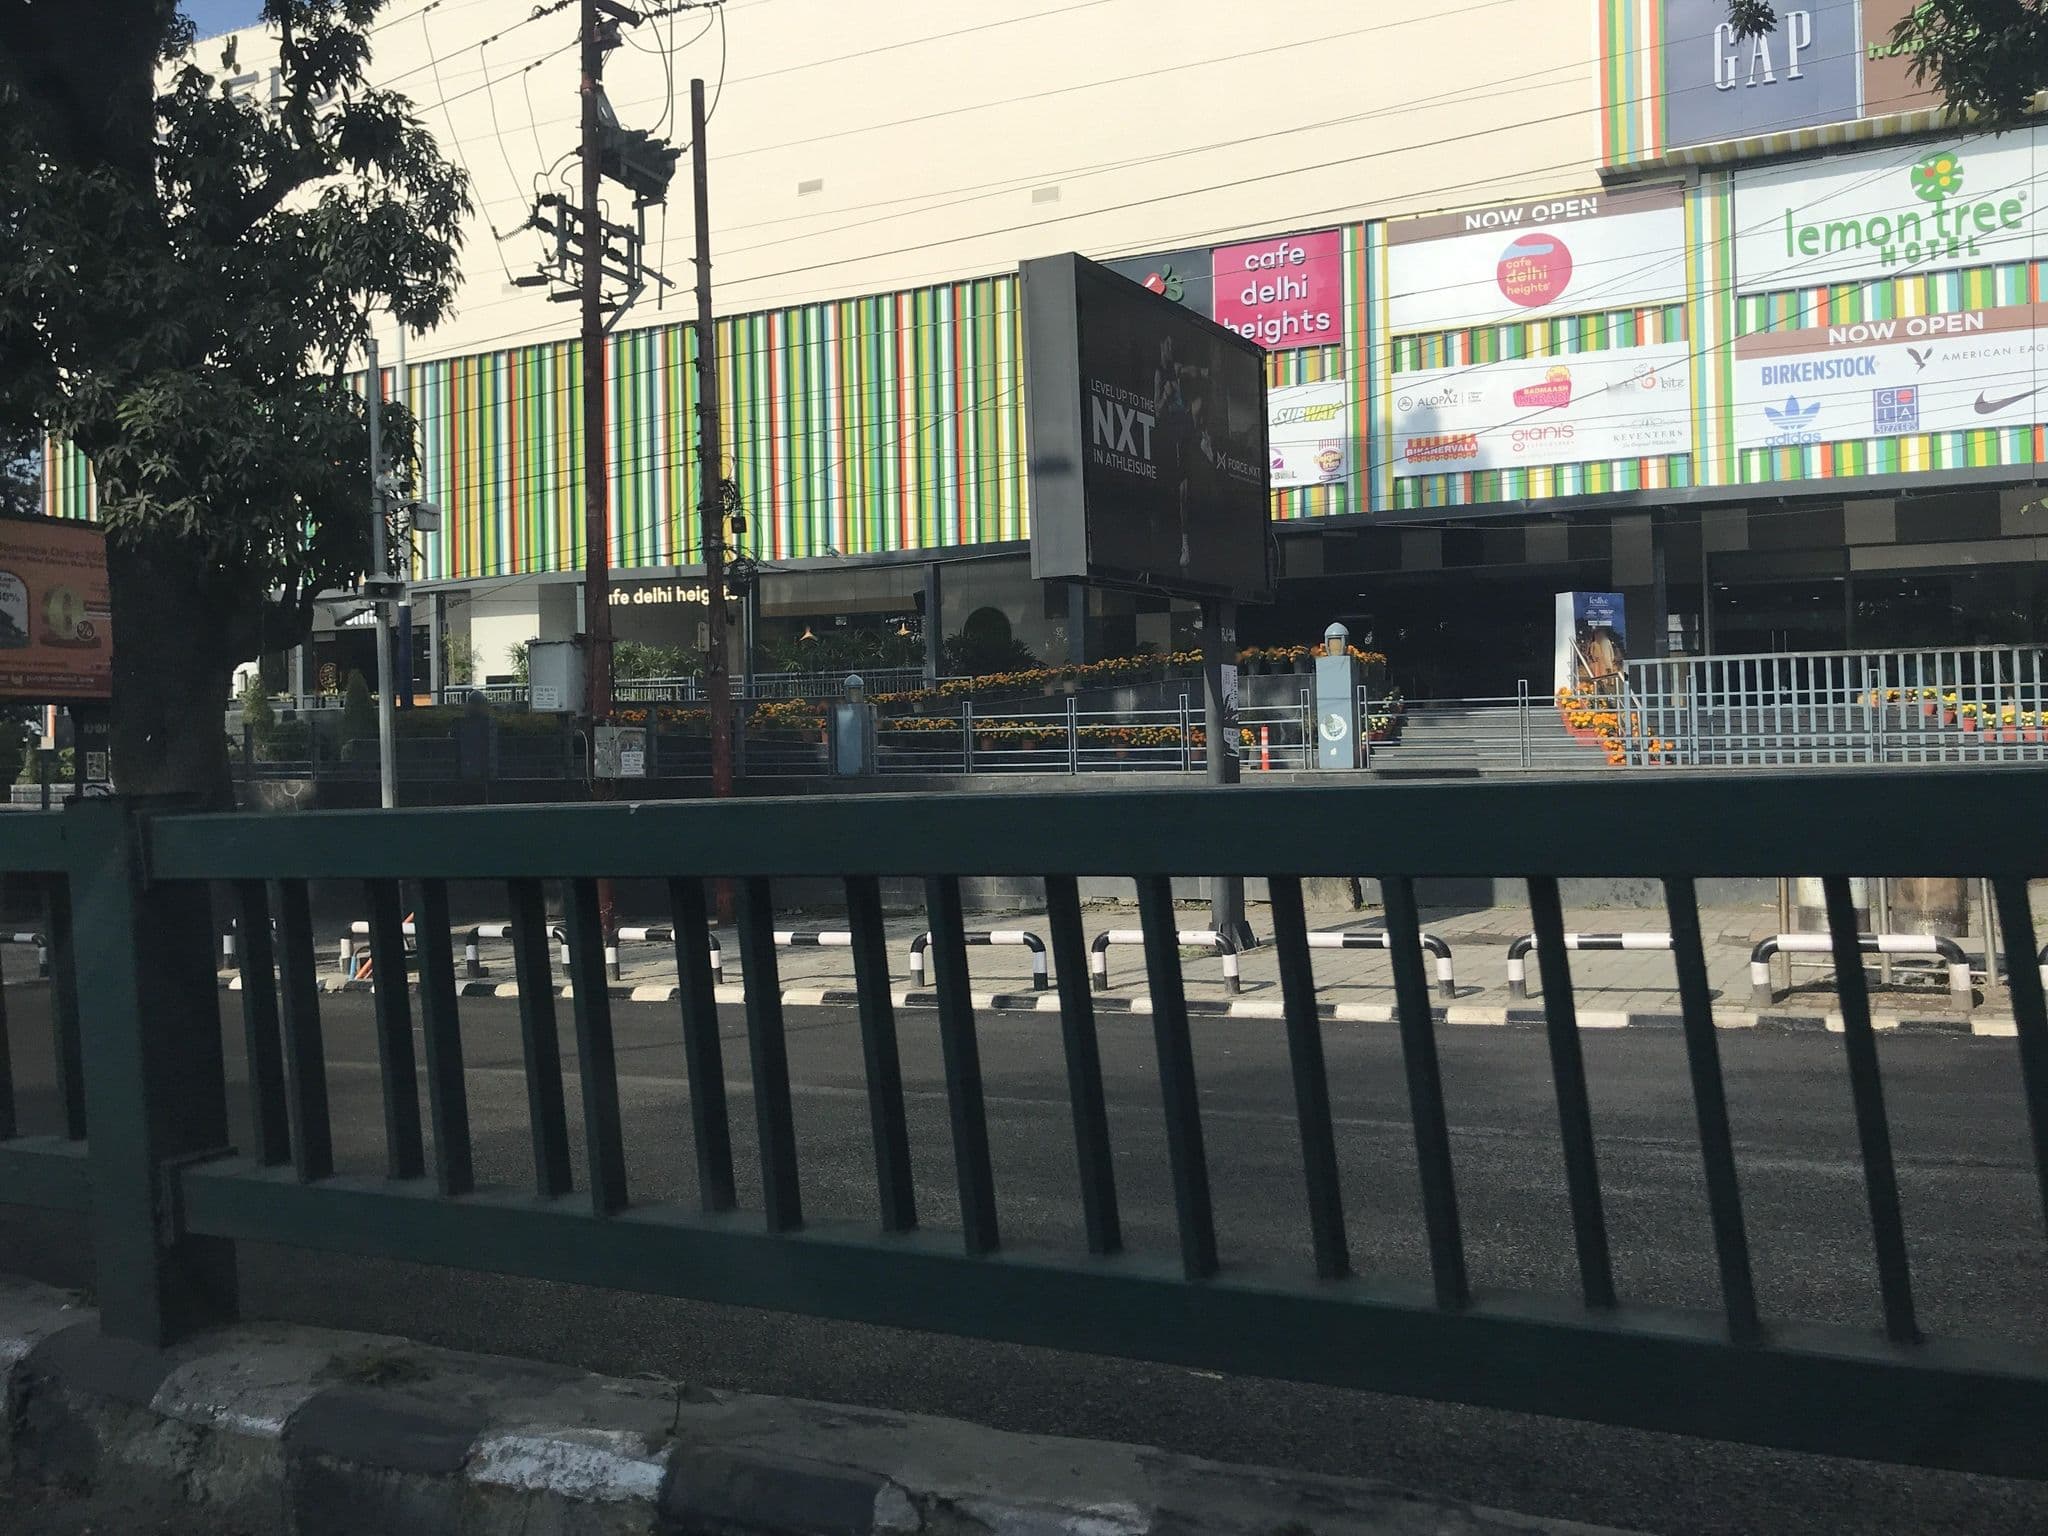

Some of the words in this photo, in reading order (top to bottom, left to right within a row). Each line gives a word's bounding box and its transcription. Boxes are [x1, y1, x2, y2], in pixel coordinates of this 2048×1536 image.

[1713, 10, 1812, 91] GAP
[1465, 209, 1524, 231] NOW
[1531, 197, 1599, 222] OPEN
[1785, 207, 1922, 258] lemon
[1932, 197, 2024, 240] tree
[1244, 242, 1306, 272] cafe
[1505, 256, 1532, 270] cafe
[1880, 234, 1982, 268] HOTEL
[1240, 273, 1308, 306] delhi
[1505, 263, 1548, 285] delhi
[1828, 321, 1897, 347] NOW
[1906, 312, 1985, 337] OPEN
[1941, 346, 2012, 362] AMERICAN
[2019, 343, 2048, 355] EAG
[1761, 354, 1877, 387] BIRKENSTOCK
[1090, 378, 1117, 400] LEVEL
[1116, 387, 1128, 402] UP
[1129, 391, 1139, 405] TO
[1138, 394, 1155, 413] THE
[1091, 395, 1156, 461] NXT
[1272, 401, 1344, 425] SUBWAY
[1406, 442, 1478, 458] BIKANERVALA
[1613, 429, 1684, 442] KEVENTERS
[1764, 431, 1822, 447] adidas
[1093, 448, 1105, 464] IN
[1105, 452, 1158, 480] ATHLEISURE
[633, 585, 673, 605] delhi
